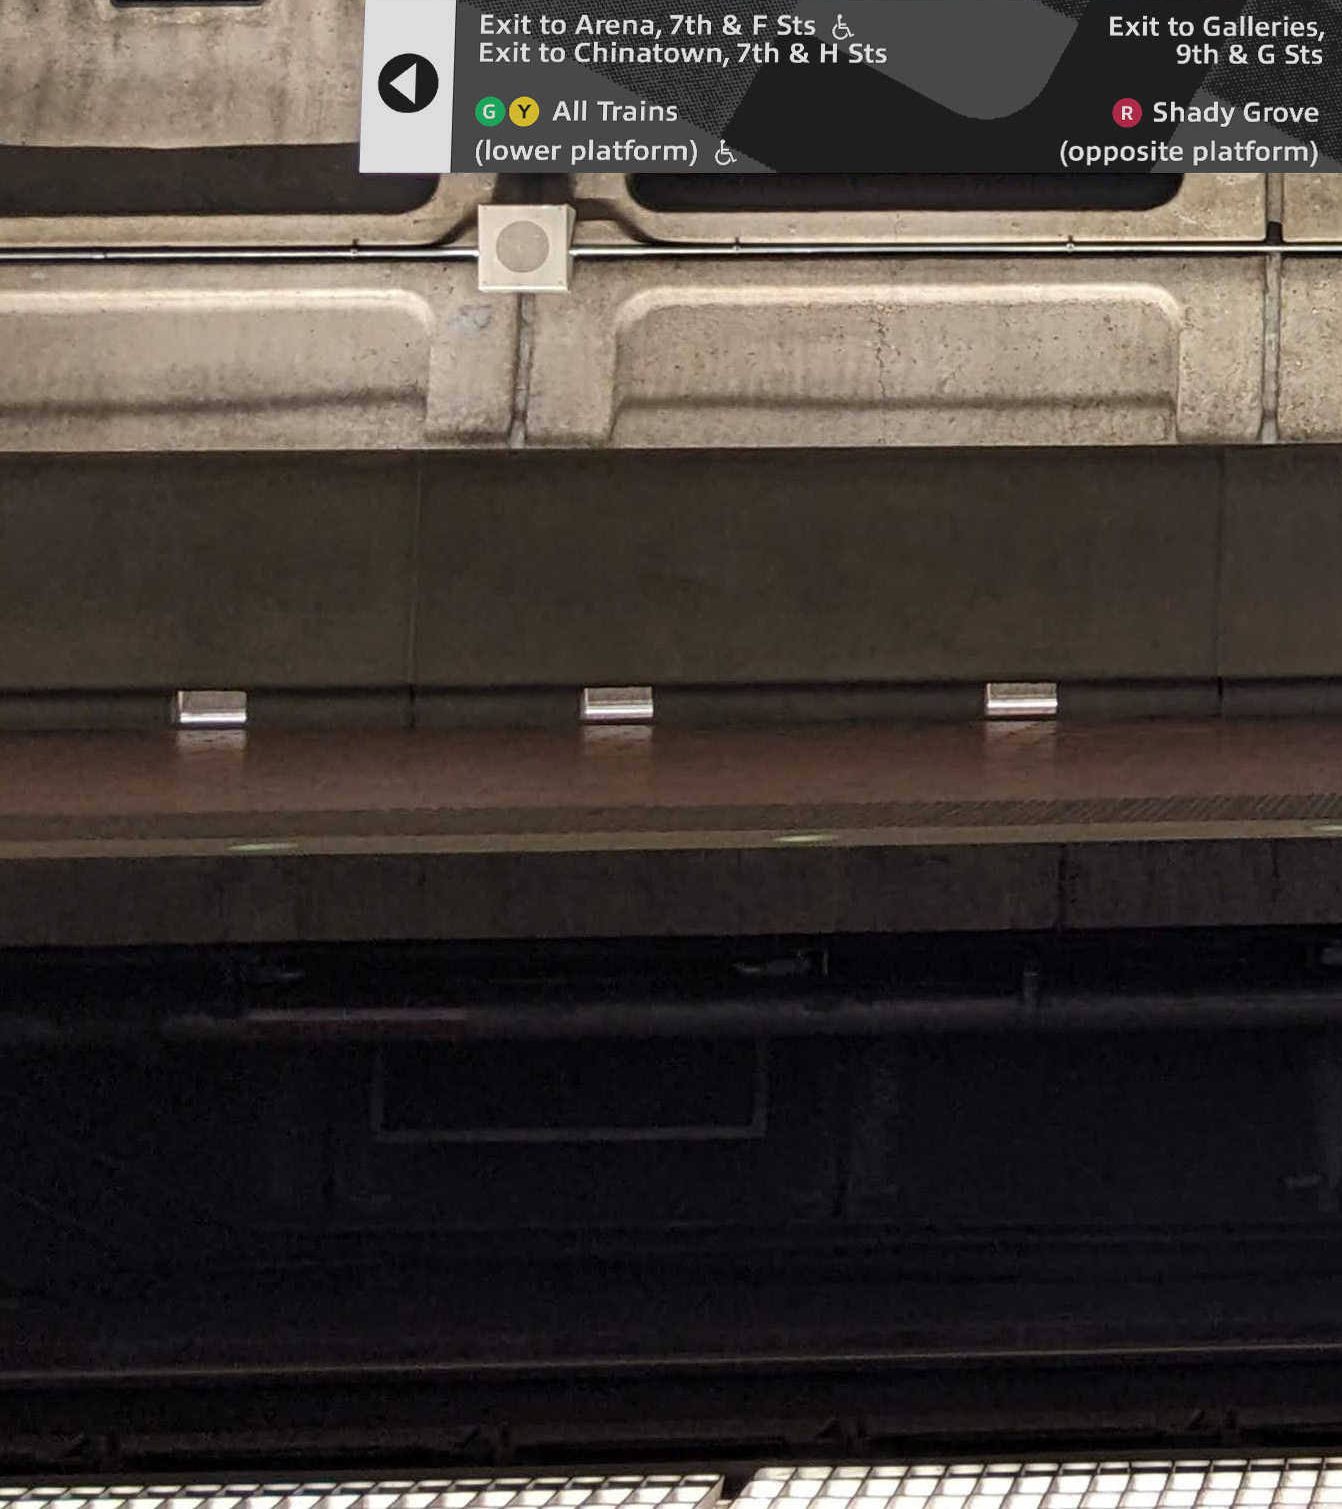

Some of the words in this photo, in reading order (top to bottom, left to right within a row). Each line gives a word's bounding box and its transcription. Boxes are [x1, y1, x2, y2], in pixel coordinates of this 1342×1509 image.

[481, 14, 531, 34] Exit
[540, 16, 566, 34] to
[575, 15, 661, 39] Arena,
[670, 15, 711, 35] 7th
[723, 15, 742, 35] &
[754, 16, 767, 34] F
[778, 15, 815, 35] Sts
[1110, 16, 1159, 36] Exit
[1168, 18, 1194, 36] to
[1204, 16, 1324, 41] Galleries,
[480, 42, 530, 62] Exit
[539, 44, 565, 62] to
[575, 42, 729, 67] Chinatown,
[738, 43, 778, 63] 7th
[790, 44, 808, 63] &
[821, 44, 837, 62] H
[849, 44, 886, 63] Sts
[1177, 44, 1217, 64] 9th
[1229, 45, 1247, 64] &
[1258, 45, 1274, 64] G
[1286, 45, 1322, 64] Sts
[483, 104, 495, 119] G
[518, 105, 531, 118] Y
[553, 101, 586, 120] All
[597, 101, 677, 121] Trains
[1122, 106, 1133, 120] R
[1154, 102, 1235, 127] Shady
[1244, 102, 1318, 122] Grove
[476, 140, 561, 166] (lower
[572, 140, 697, 166] platform)
[1061, 141, 1183, 166] (opposite
[1194, 141, 1317, 167] platform)
